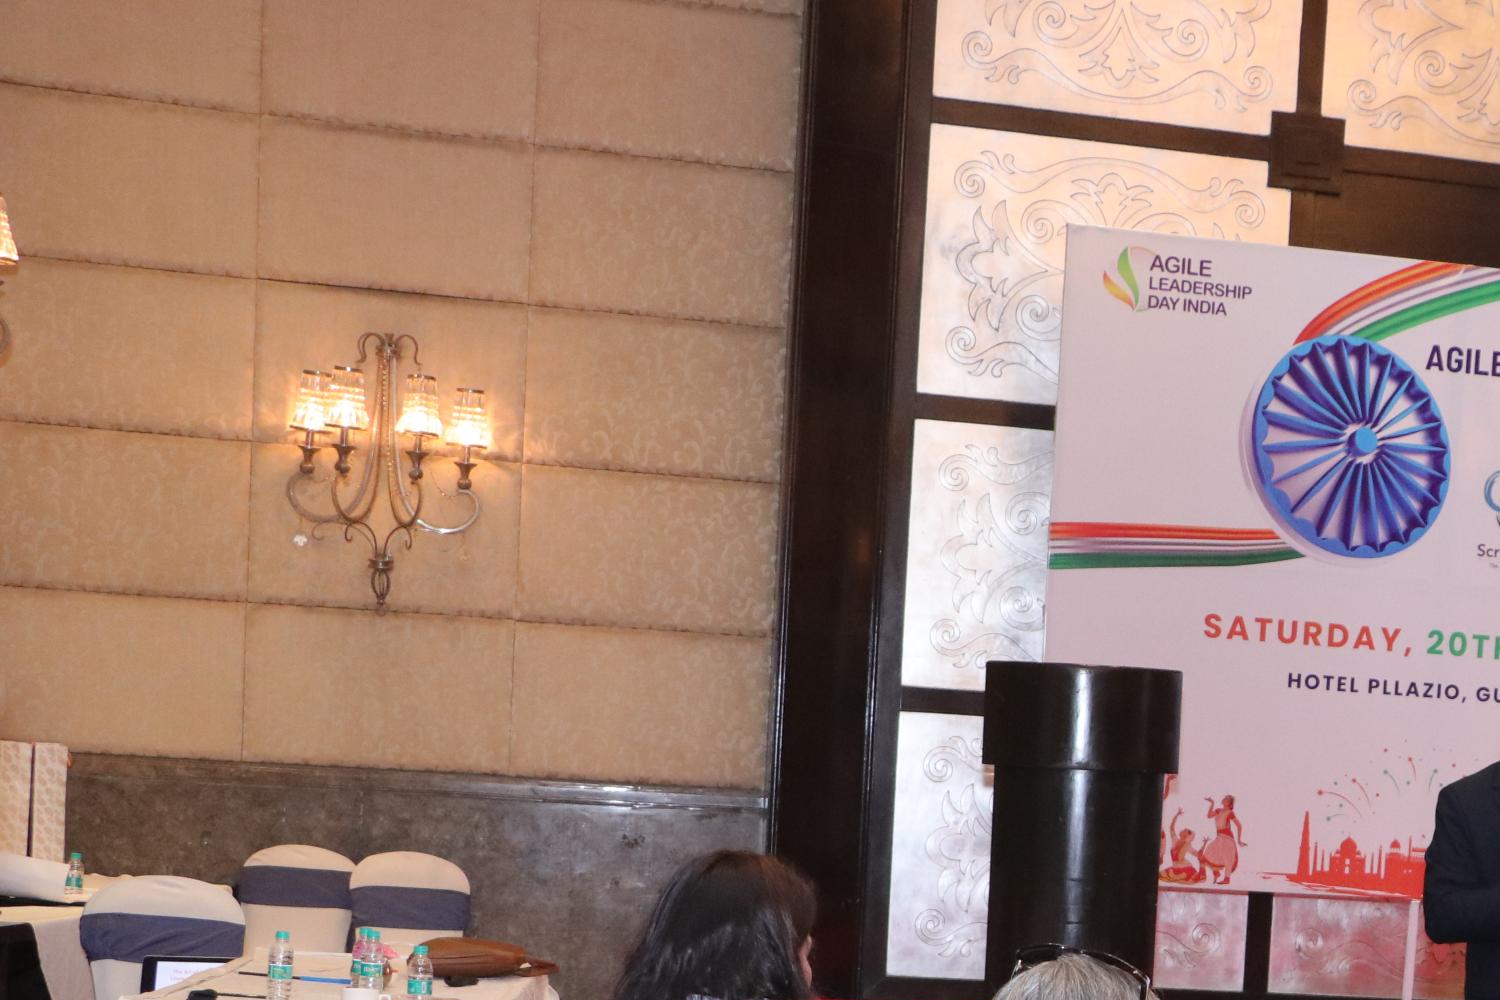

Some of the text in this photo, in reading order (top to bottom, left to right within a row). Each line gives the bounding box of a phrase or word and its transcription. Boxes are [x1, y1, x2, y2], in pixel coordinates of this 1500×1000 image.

[1150, 254, 1213, 277] AGILE
[1149, 276, 1252, 299] LEADERSHIP
[1148, 295, 1227, 316] DAY INDIA
[1203, 613, 1411, 657] SATURDAY,
[1287, 672, 1358, 693] HOTEL
[1368, 678, 1466, 703] PLLAZIO,
